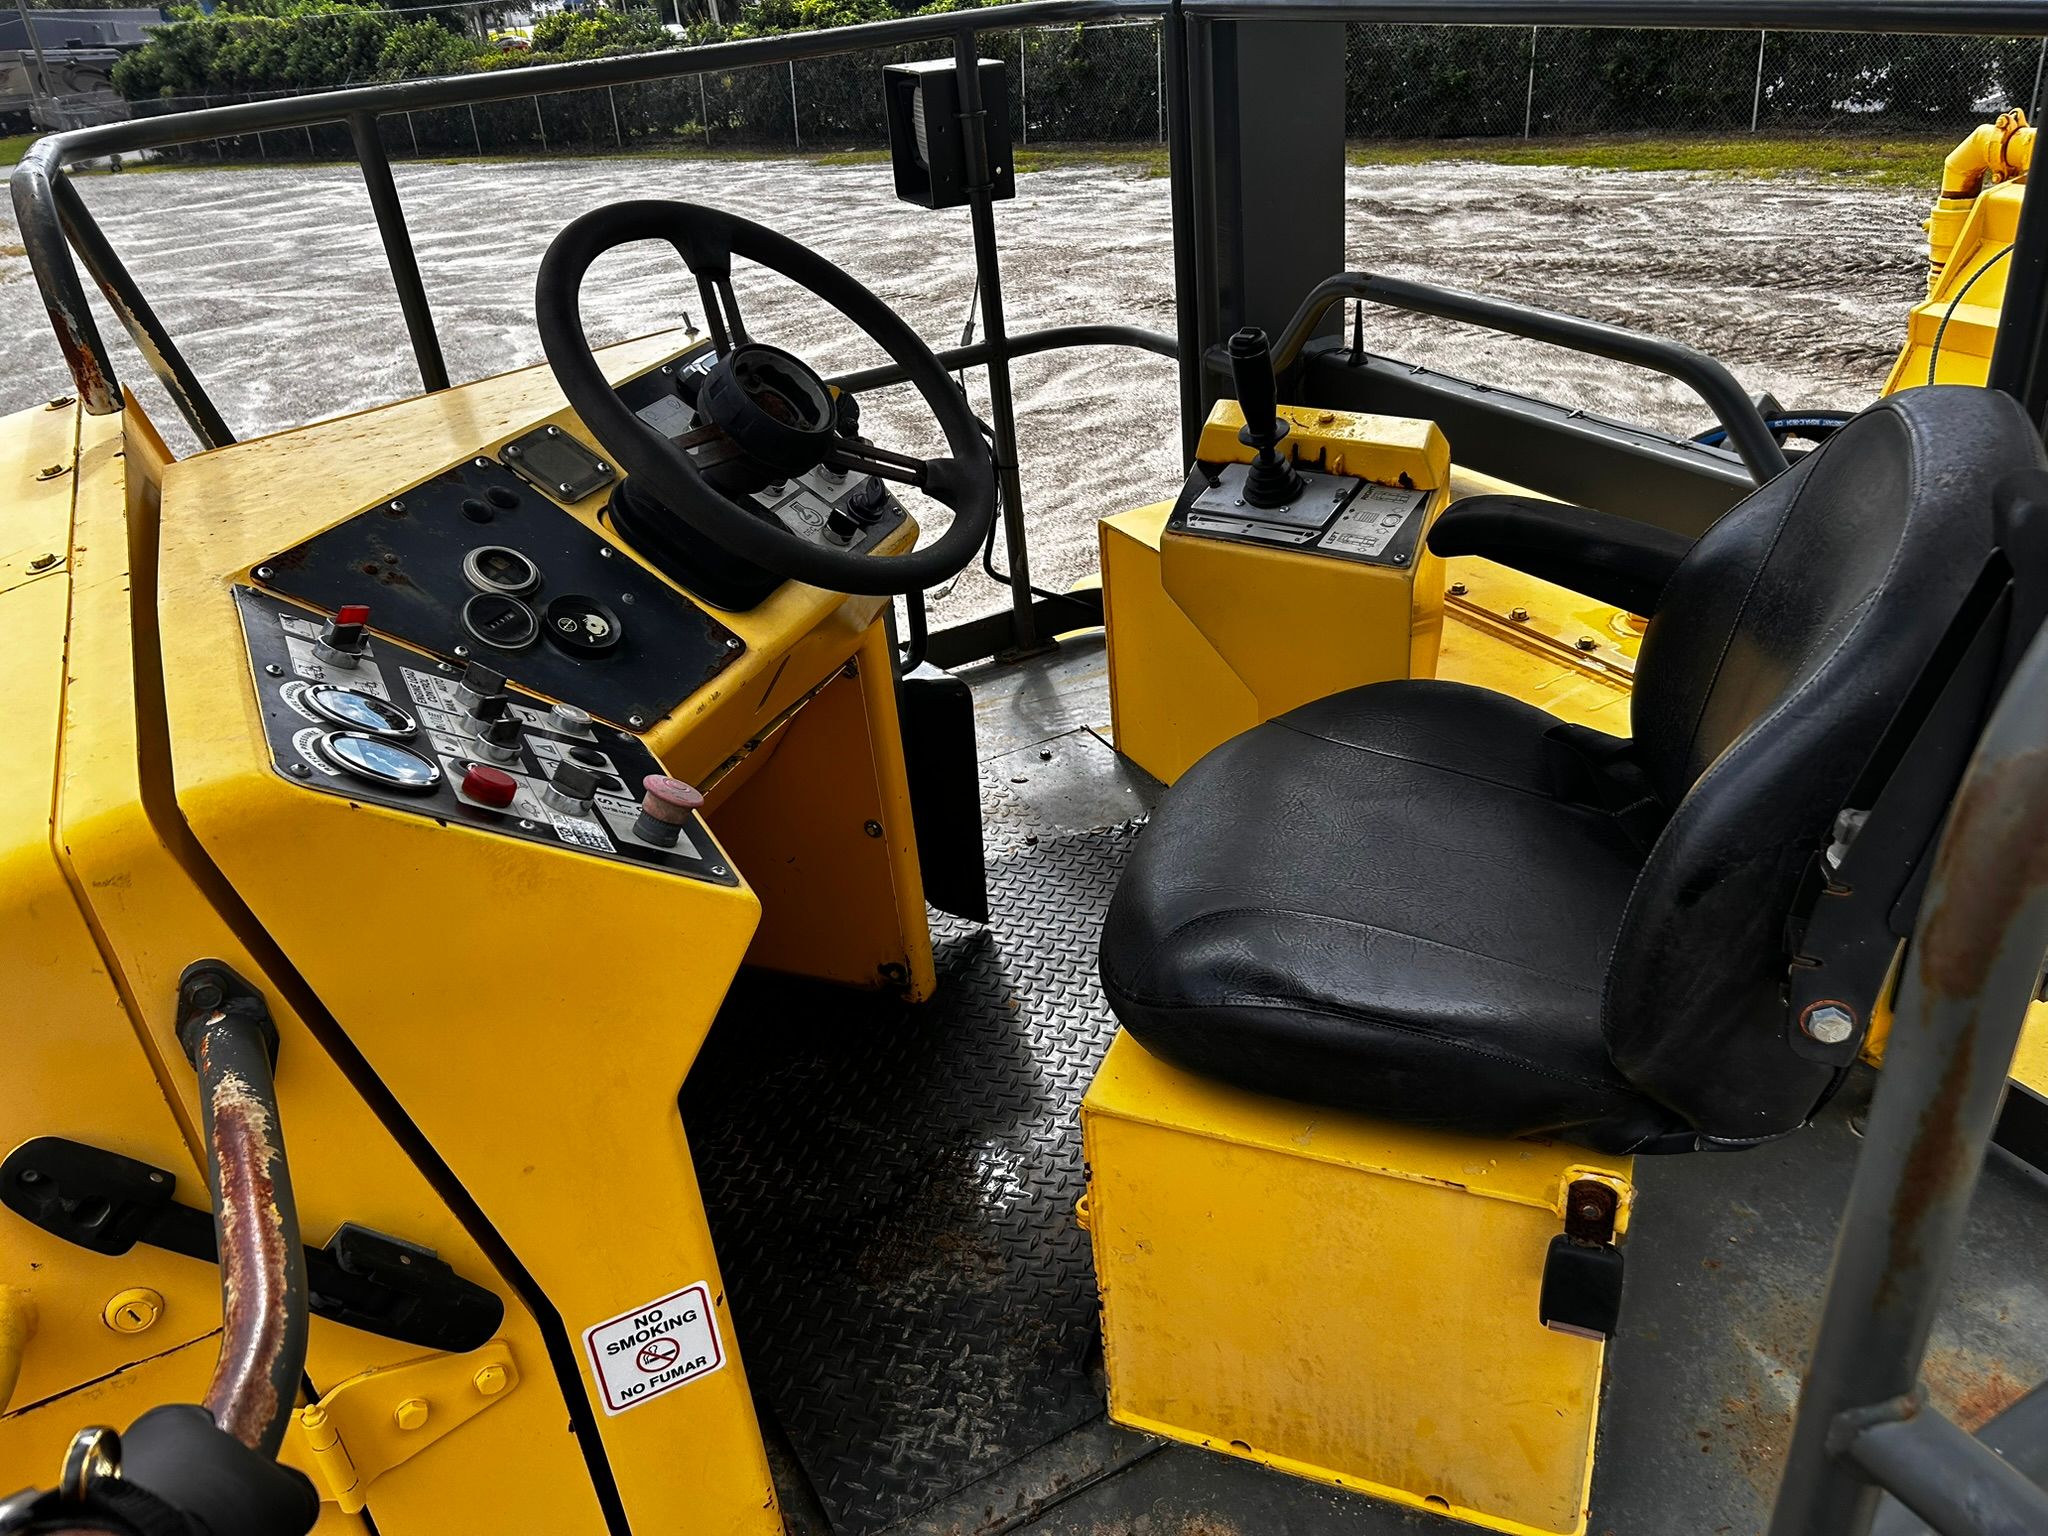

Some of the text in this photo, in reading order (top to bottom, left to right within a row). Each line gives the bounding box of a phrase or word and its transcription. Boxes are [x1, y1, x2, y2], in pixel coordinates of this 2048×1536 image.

[1326, 531, 1340, 544] LEFT
[304, 751, 333, 772] ROTOR
[634, 1309, 663, 1330] NO
[606, 1309, 697, 1355] SMOKING
[620, 1356, 707, 1400] NO FUMAR
